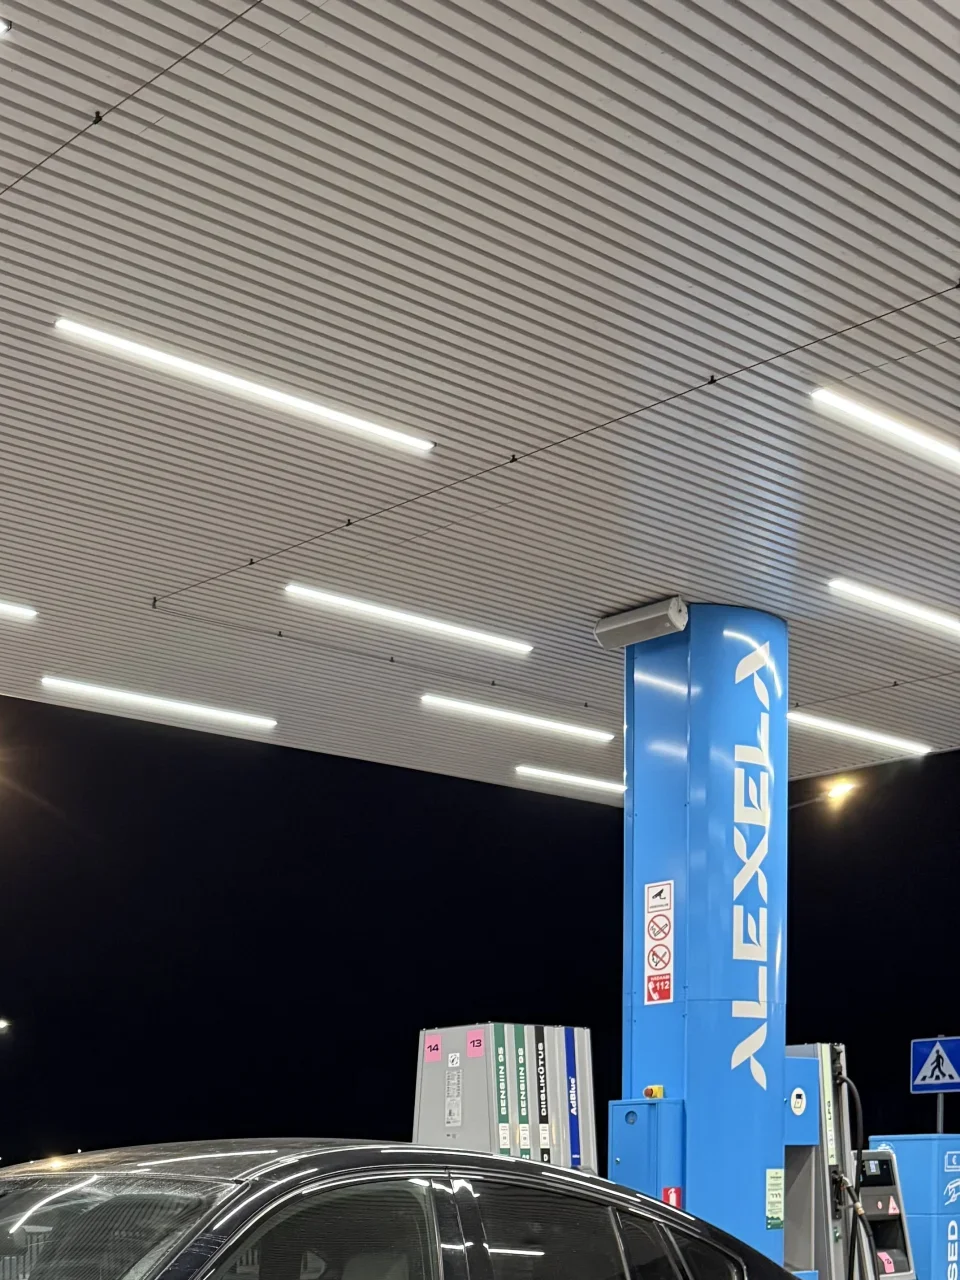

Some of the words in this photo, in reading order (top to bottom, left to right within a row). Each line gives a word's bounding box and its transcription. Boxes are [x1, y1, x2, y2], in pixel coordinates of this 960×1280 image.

[731, 642, 770, 1091] ALEXELA
[656, 981, 669, 991] 112
[427, 1044, 439, 1052] 14
[470, 1039, 482, 1048] 13
[498, 1047, 504, 1062] 95
[499, 1066, 507, 1115] BENSIIN
[519, 1067, 527, 1116] BENSIIN
